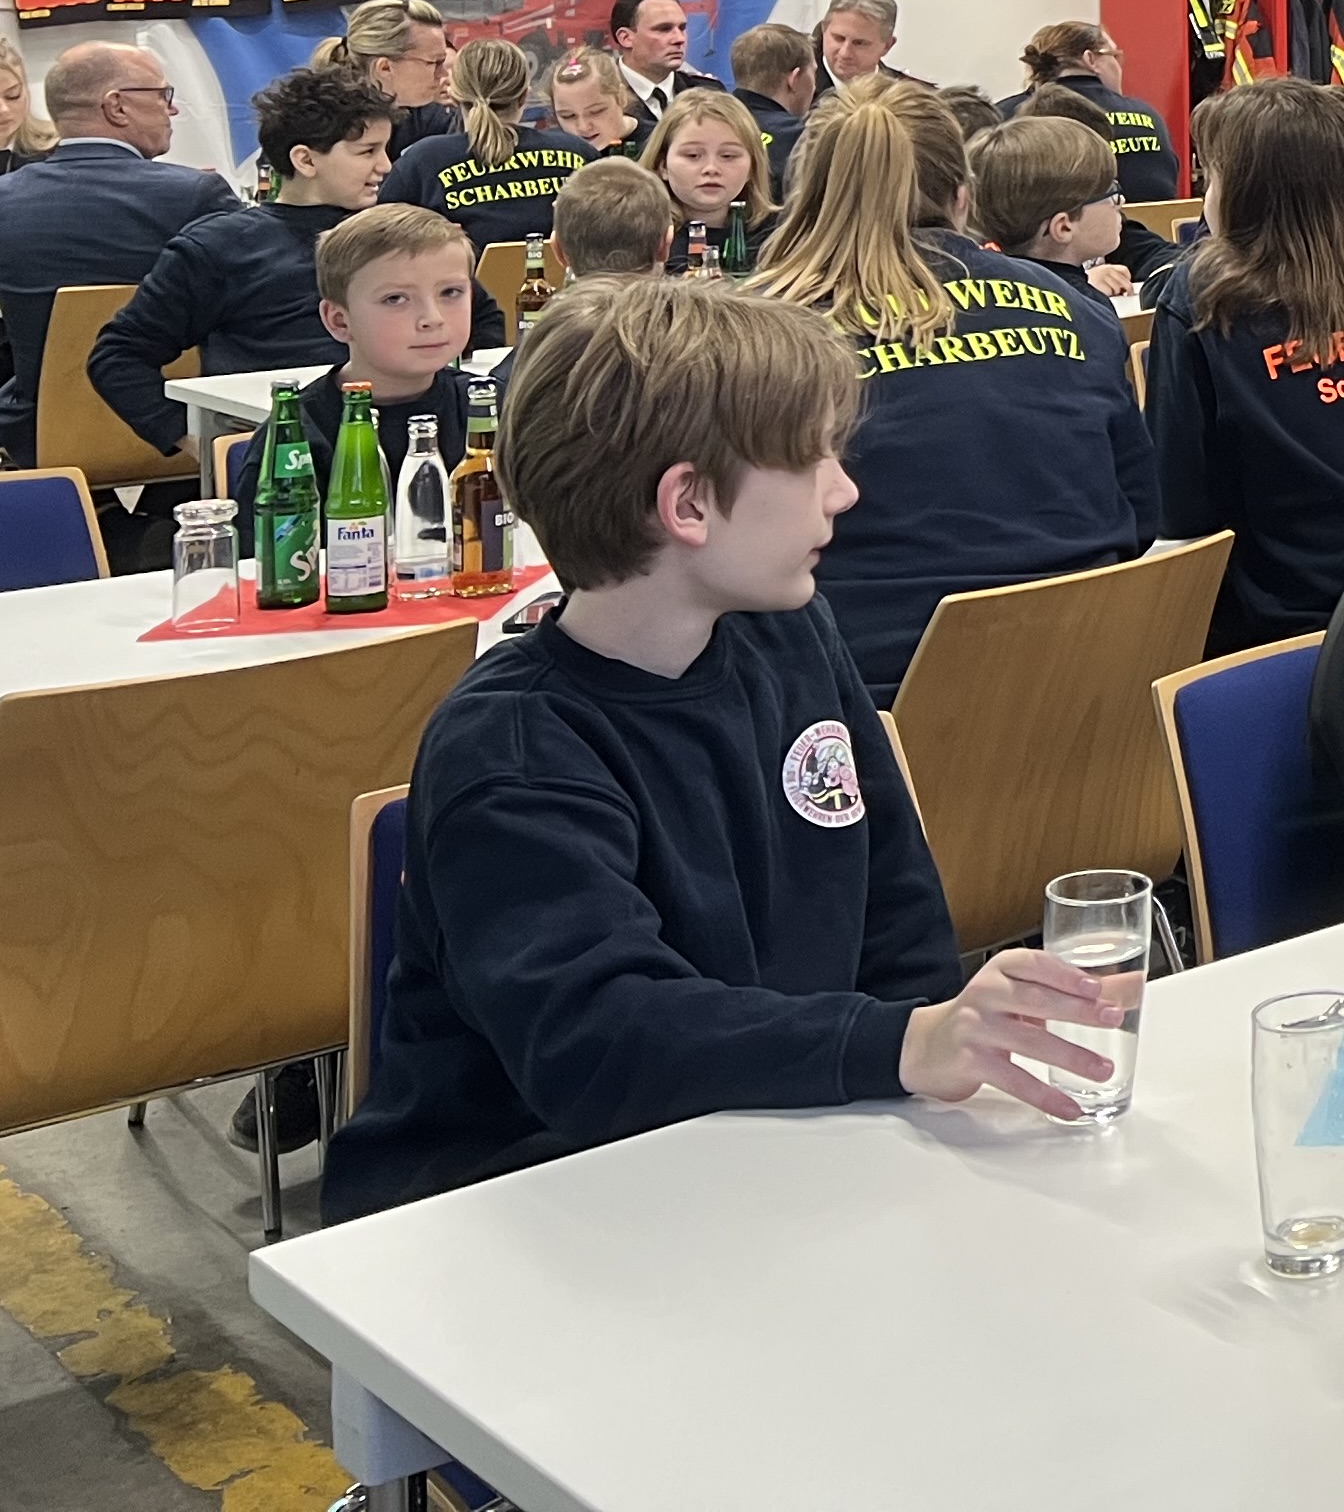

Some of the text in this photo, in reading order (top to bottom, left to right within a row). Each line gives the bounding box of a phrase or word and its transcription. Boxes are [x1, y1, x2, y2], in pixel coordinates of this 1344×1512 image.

[1109, 136, 1160, 155] BEUTZ
[445, 177, 568, 210] SCHARBEU
[854, 326, 1086, 379] CHARBEUTZ
[338, 527, 374, 540] Fanta
